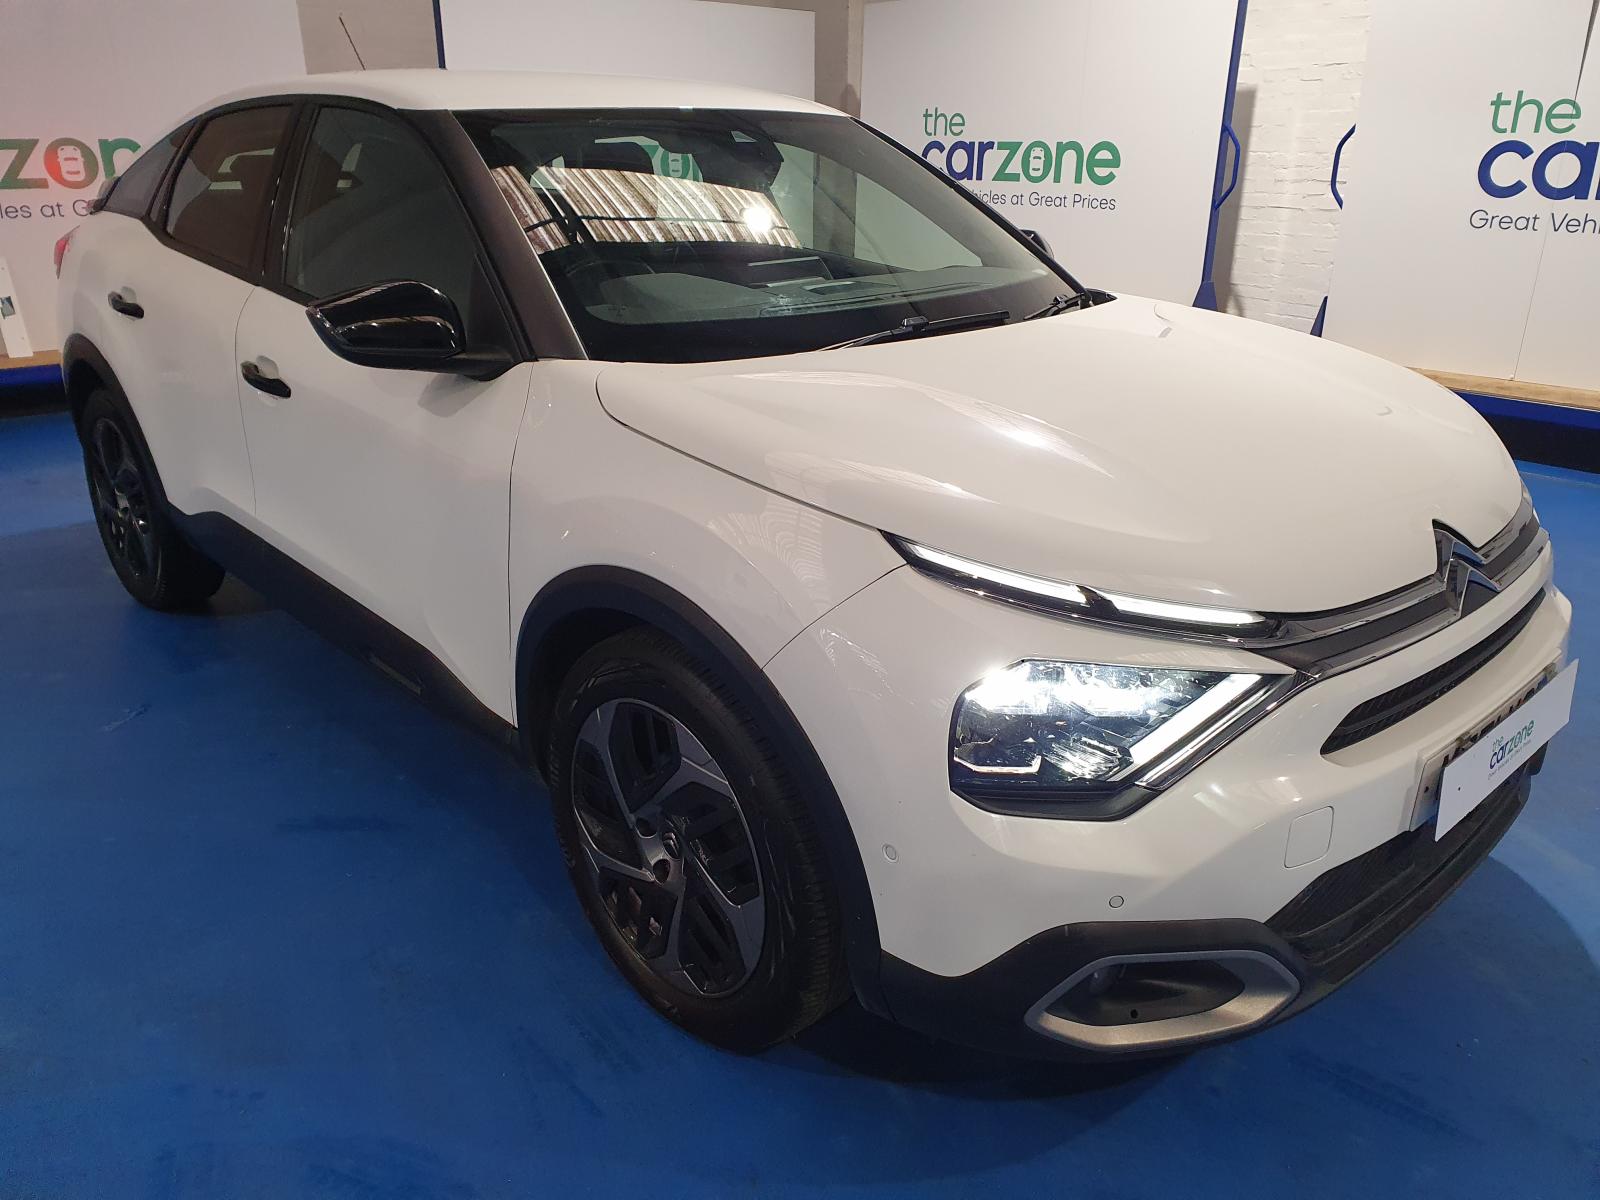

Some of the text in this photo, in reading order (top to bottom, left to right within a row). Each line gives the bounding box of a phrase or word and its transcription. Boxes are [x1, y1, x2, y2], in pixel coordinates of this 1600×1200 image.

[922, 107, 966, 136] the
[1490, 90, 1581, 134] the
[1477, 140, 1600, 200] ca
[40, 202, 65, 218] at
[1011, 192, 1025, 206] at
[1029, 191, 1068, 208] Great
[1072, 193, 1117, 211] Prices
[1469, 209, 1541, 231] Great
[1489, 719, 1535, 769] carzone
